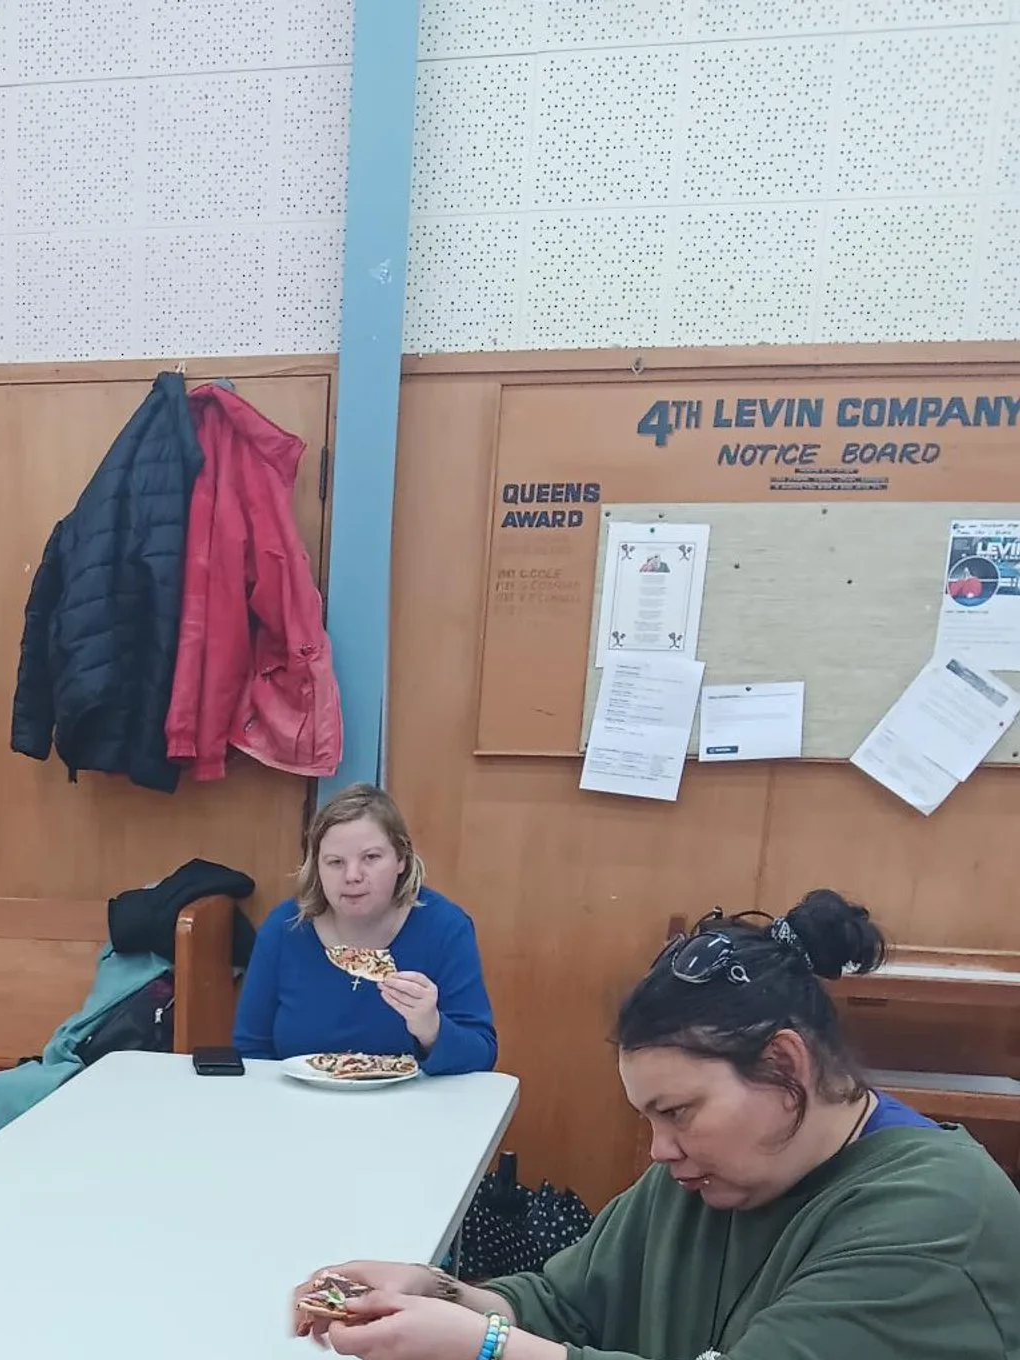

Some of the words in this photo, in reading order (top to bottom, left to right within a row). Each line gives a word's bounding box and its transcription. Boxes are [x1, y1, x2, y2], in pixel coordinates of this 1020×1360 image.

[637, 400, 702, 446] 4TH
[713, 398, 825, 428] LEVIN
[836, 396, 1020, 427] COMPANY
[717, 443, 821, 467] NOTICE
[841, 442, 941, 464] BOARD
[503, 482, 601, 504] QUEENS
[501, 510, 584, 528] AWARD
